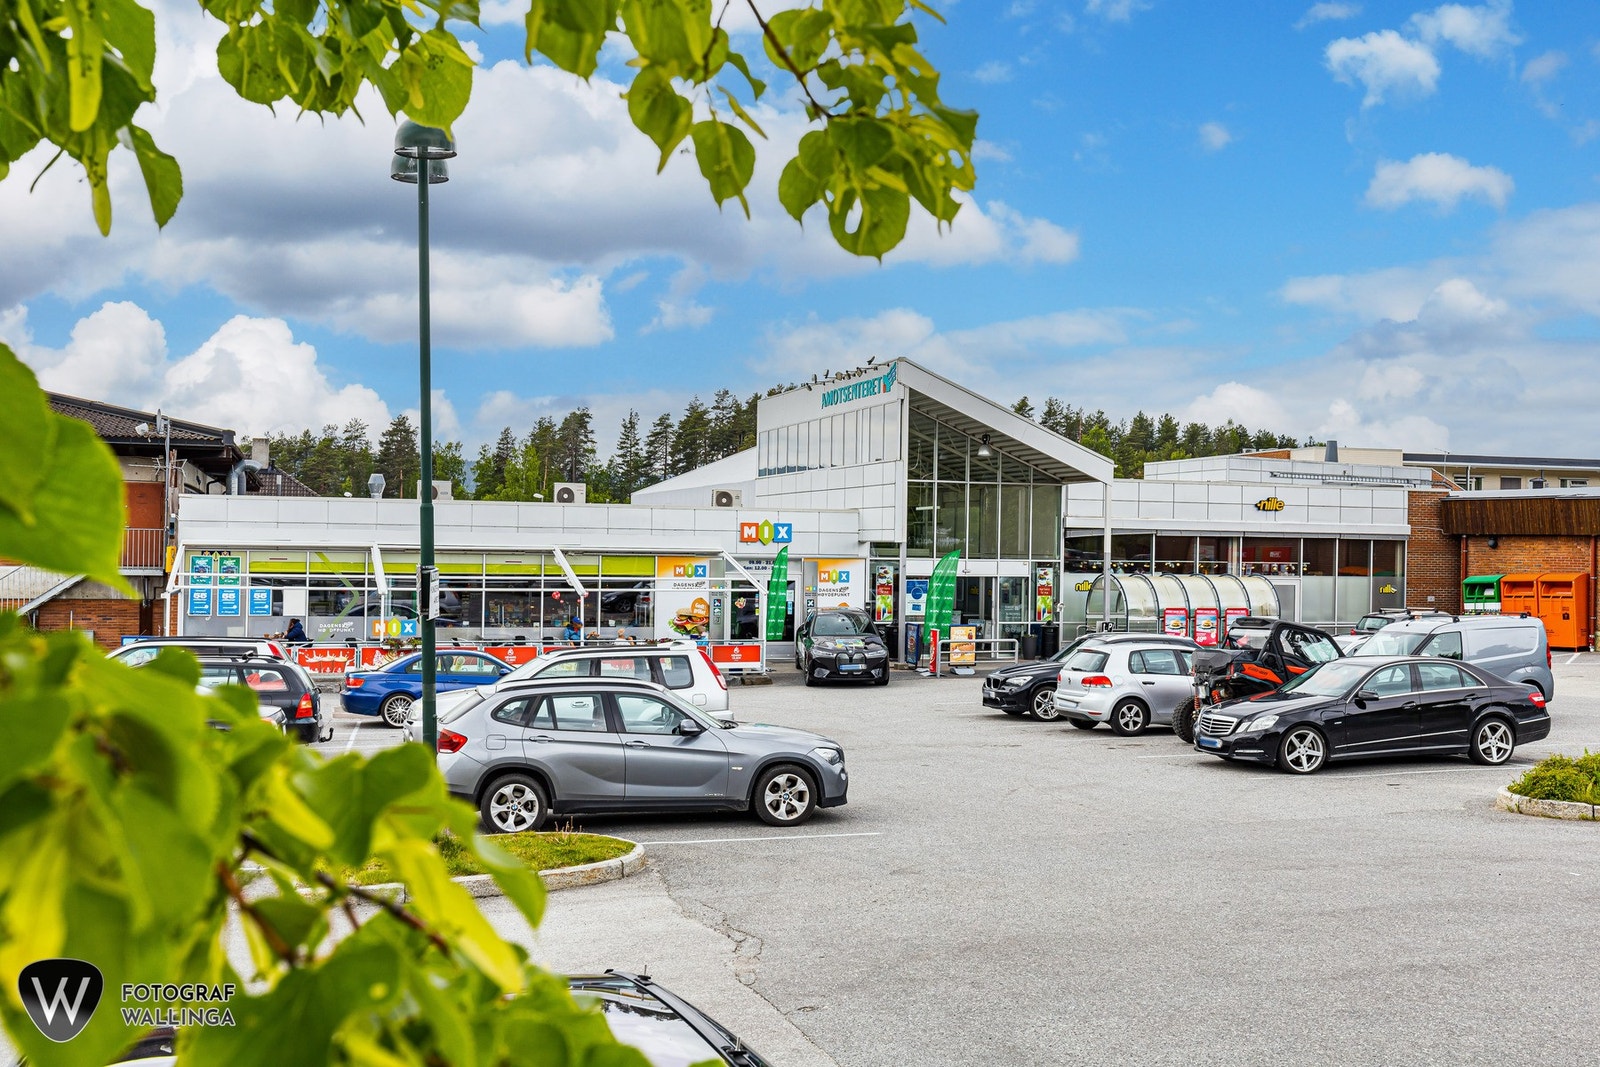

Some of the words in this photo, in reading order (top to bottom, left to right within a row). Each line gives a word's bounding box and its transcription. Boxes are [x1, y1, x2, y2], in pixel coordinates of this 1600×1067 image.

[1259, 497, 1285, 511] nille
[743, 524, 790, 540] MIX
[675, 566, 705, 576] MIX
[820, 571, 848, 581] MIX
